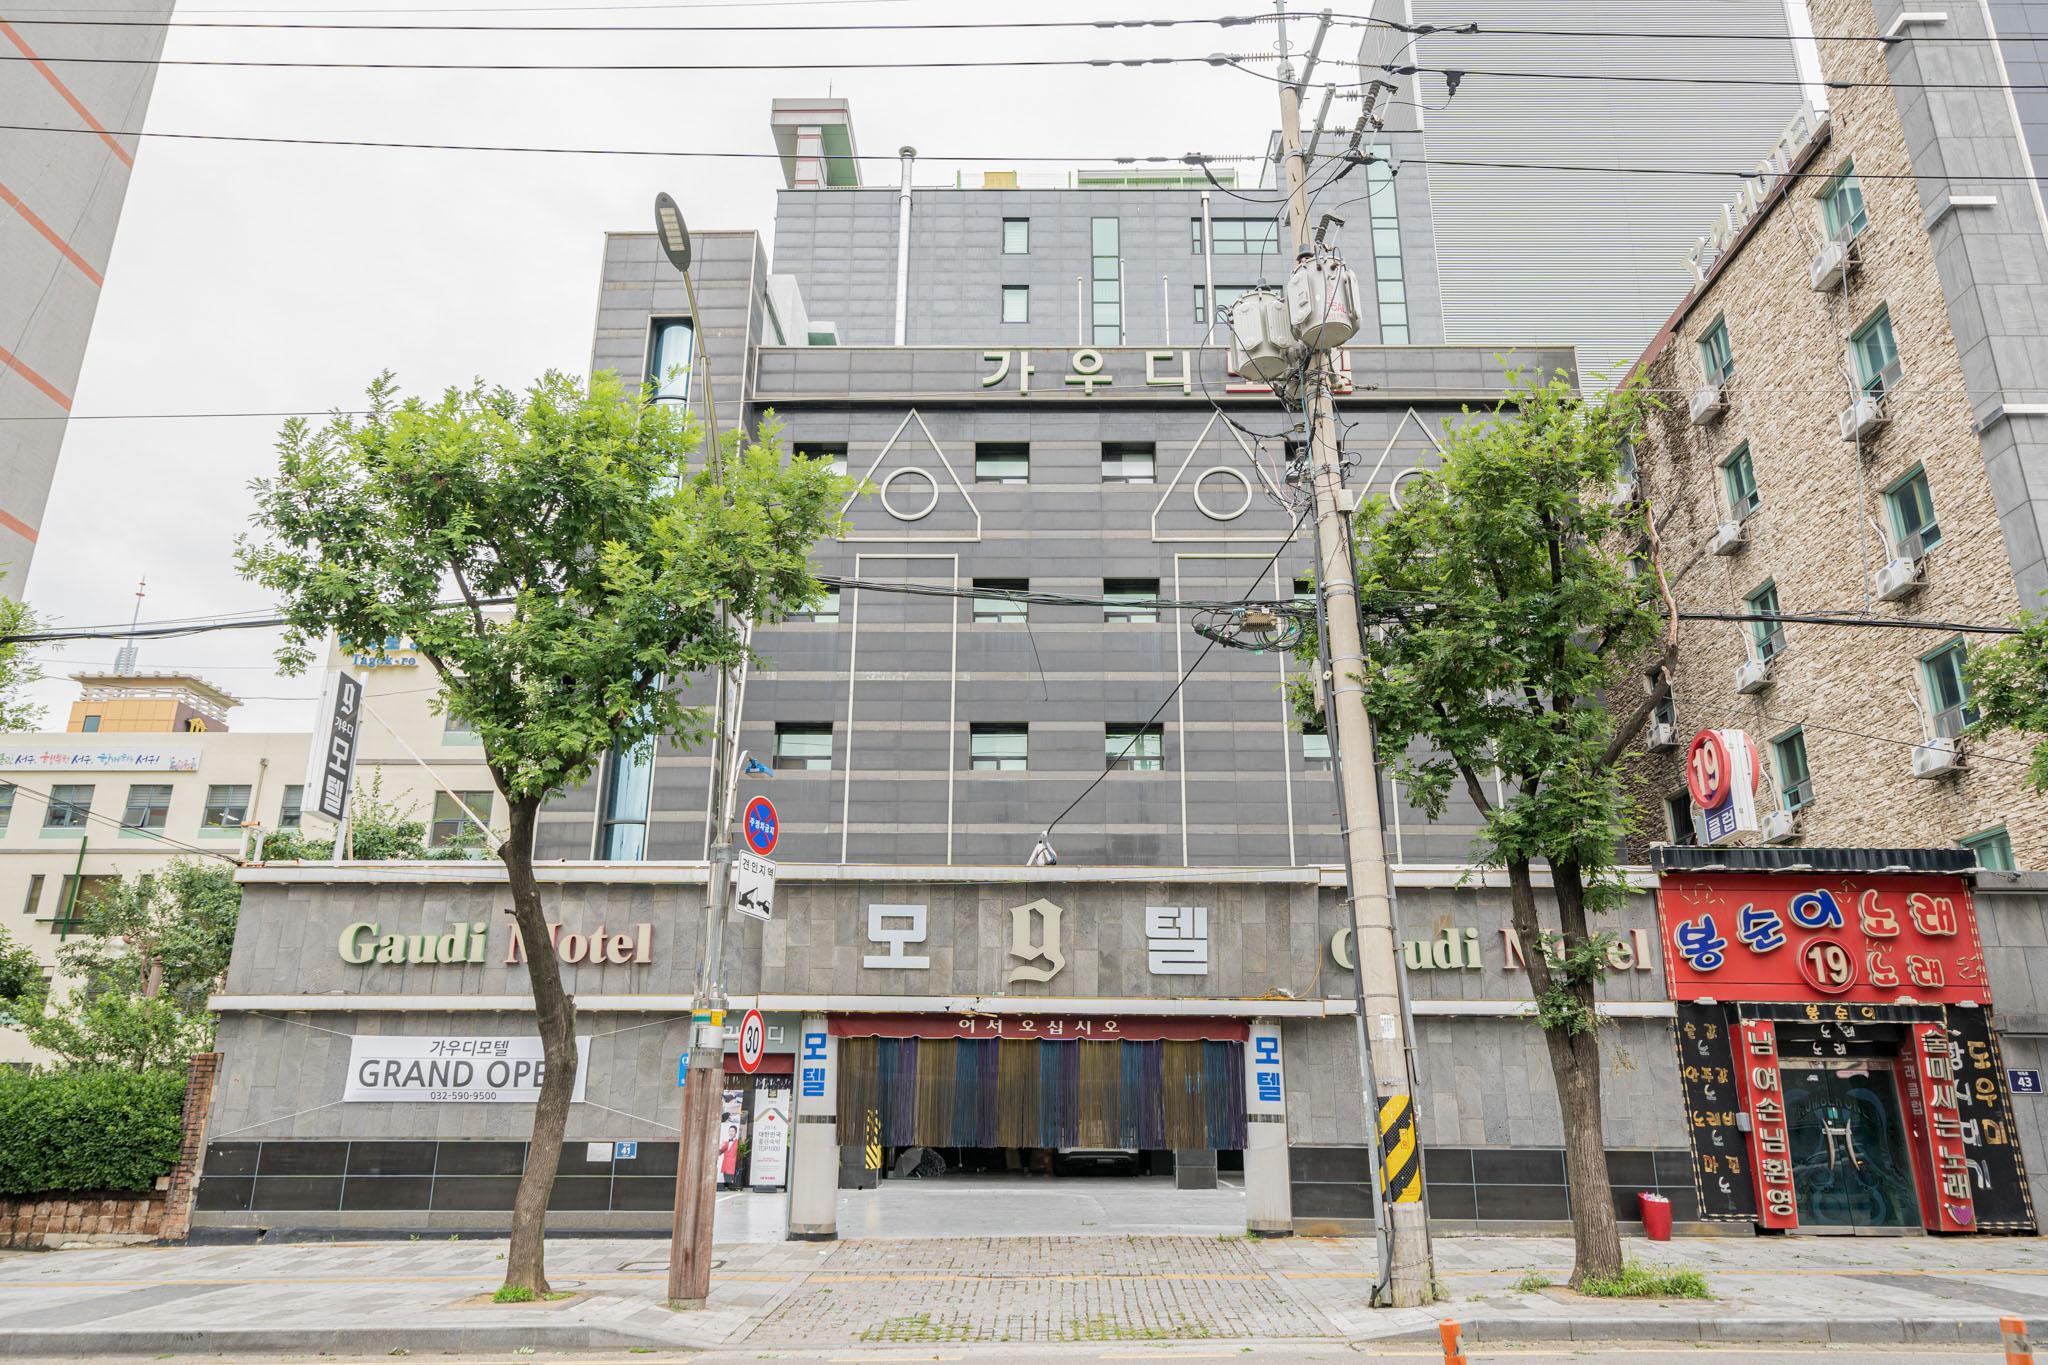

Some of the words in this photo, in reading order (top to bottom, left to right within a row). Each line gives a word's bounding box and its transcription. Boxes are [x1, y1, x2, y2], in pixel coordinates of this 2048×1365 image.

[982, 349, 1191, 396] 가우디
[334, 716, 354, 738] 가우디
[324, 736, 350, 816] 모텔
[1692, 739, 1720, 797] 19
[749, 817, 775, 836] 주정차금지
[1708, 809, 1736, 840] 클럽
[743, 858, 774, 879] 견인지역
[1858, 888, 1958, 937] 노래
[338, 921, 487, 964] Gaudi
[1807, 945, 1848, 984] 19
[1866, 950, 1945, 988] 노래
[429, 1040, 510, 1057] 가우디모텔
[745, 1025, 759, 1054] 30
[359, 1060, 474, 1088] GRAND
[486, 1060, 545, 1088] OPE
[803, 1033, 827, 1096] 모텔
[1255, 1037, 1281, 1101] 모텔
[430, 1091, 497, 1100] 032-590-9500
[2017, 1076, 2032, 1088] 43
